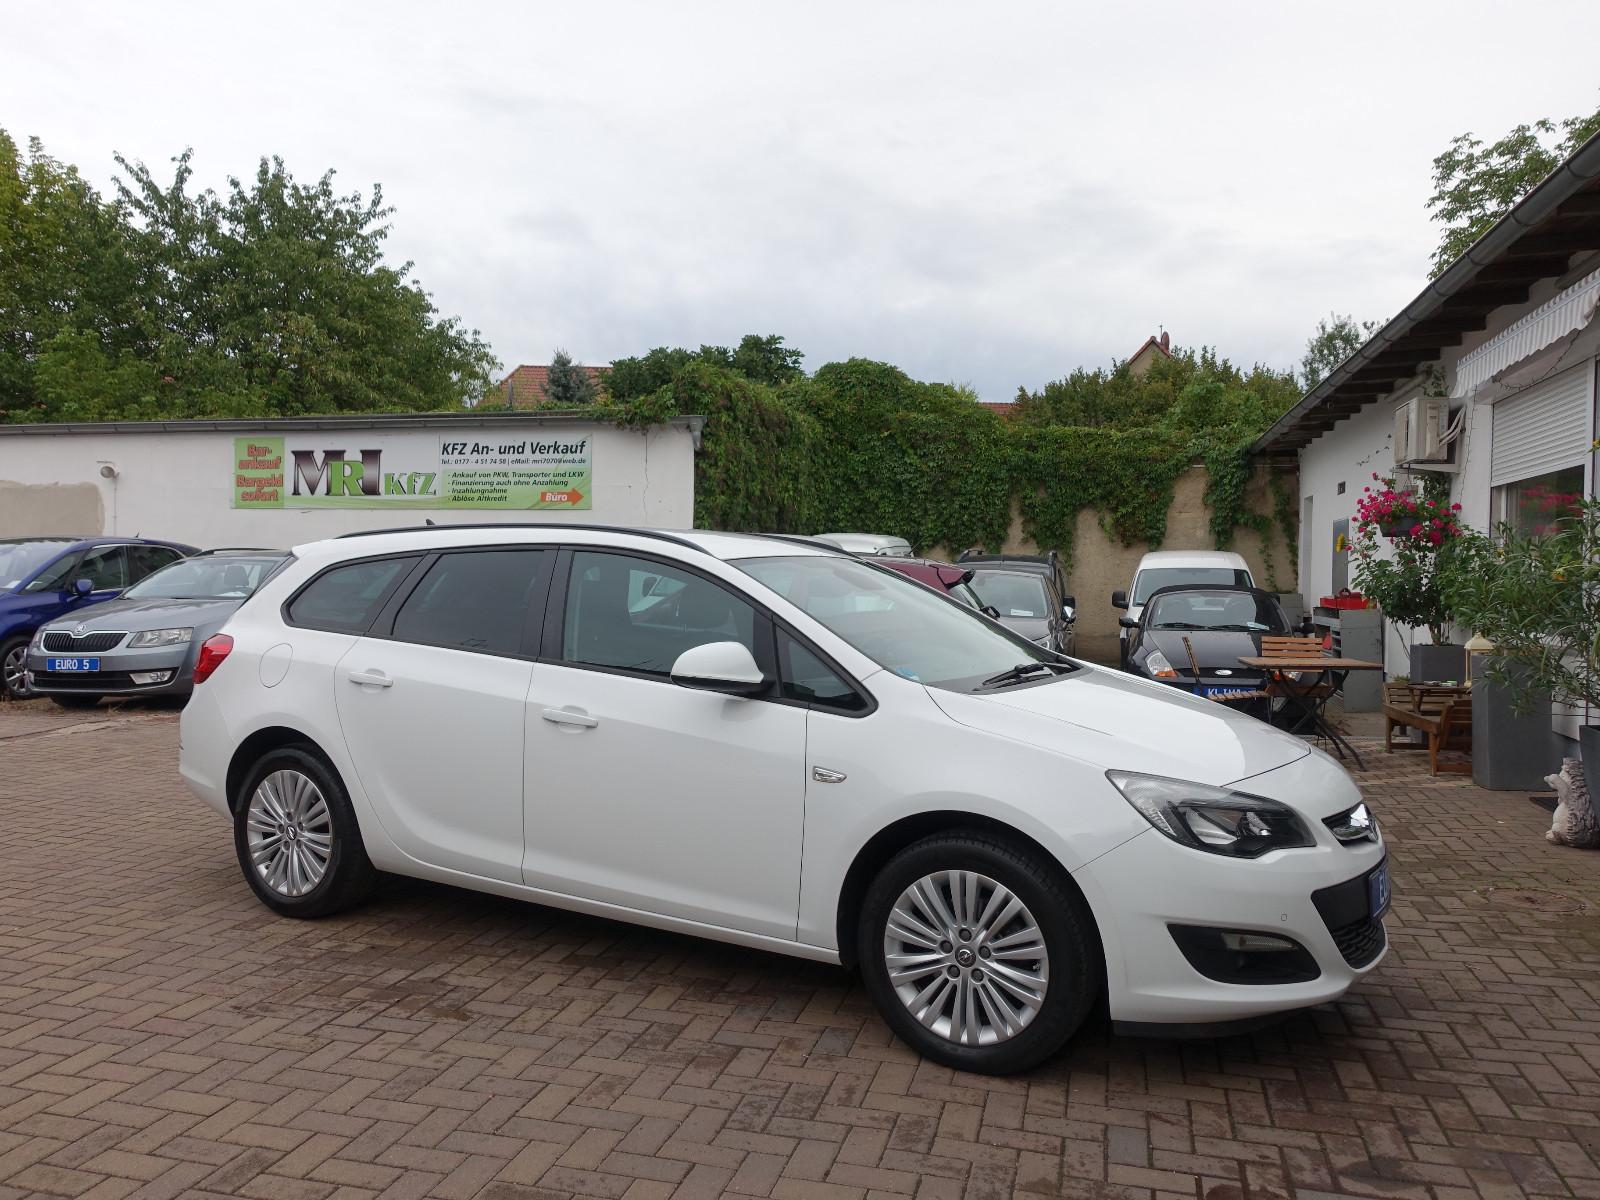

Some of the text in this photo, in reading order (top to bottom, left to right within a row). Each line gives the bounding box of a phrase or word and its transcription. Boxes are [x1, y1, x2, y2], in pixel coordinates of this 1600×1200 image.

[441, 440, 586, 455] KFZ An- und Verkauf
[512, 471, 551, 479] Transporter
[532, 479, 569, 487] Anzahlung
[545, 492, 568, 501] Büro
[55, 659, 89, 669] EURO 5
